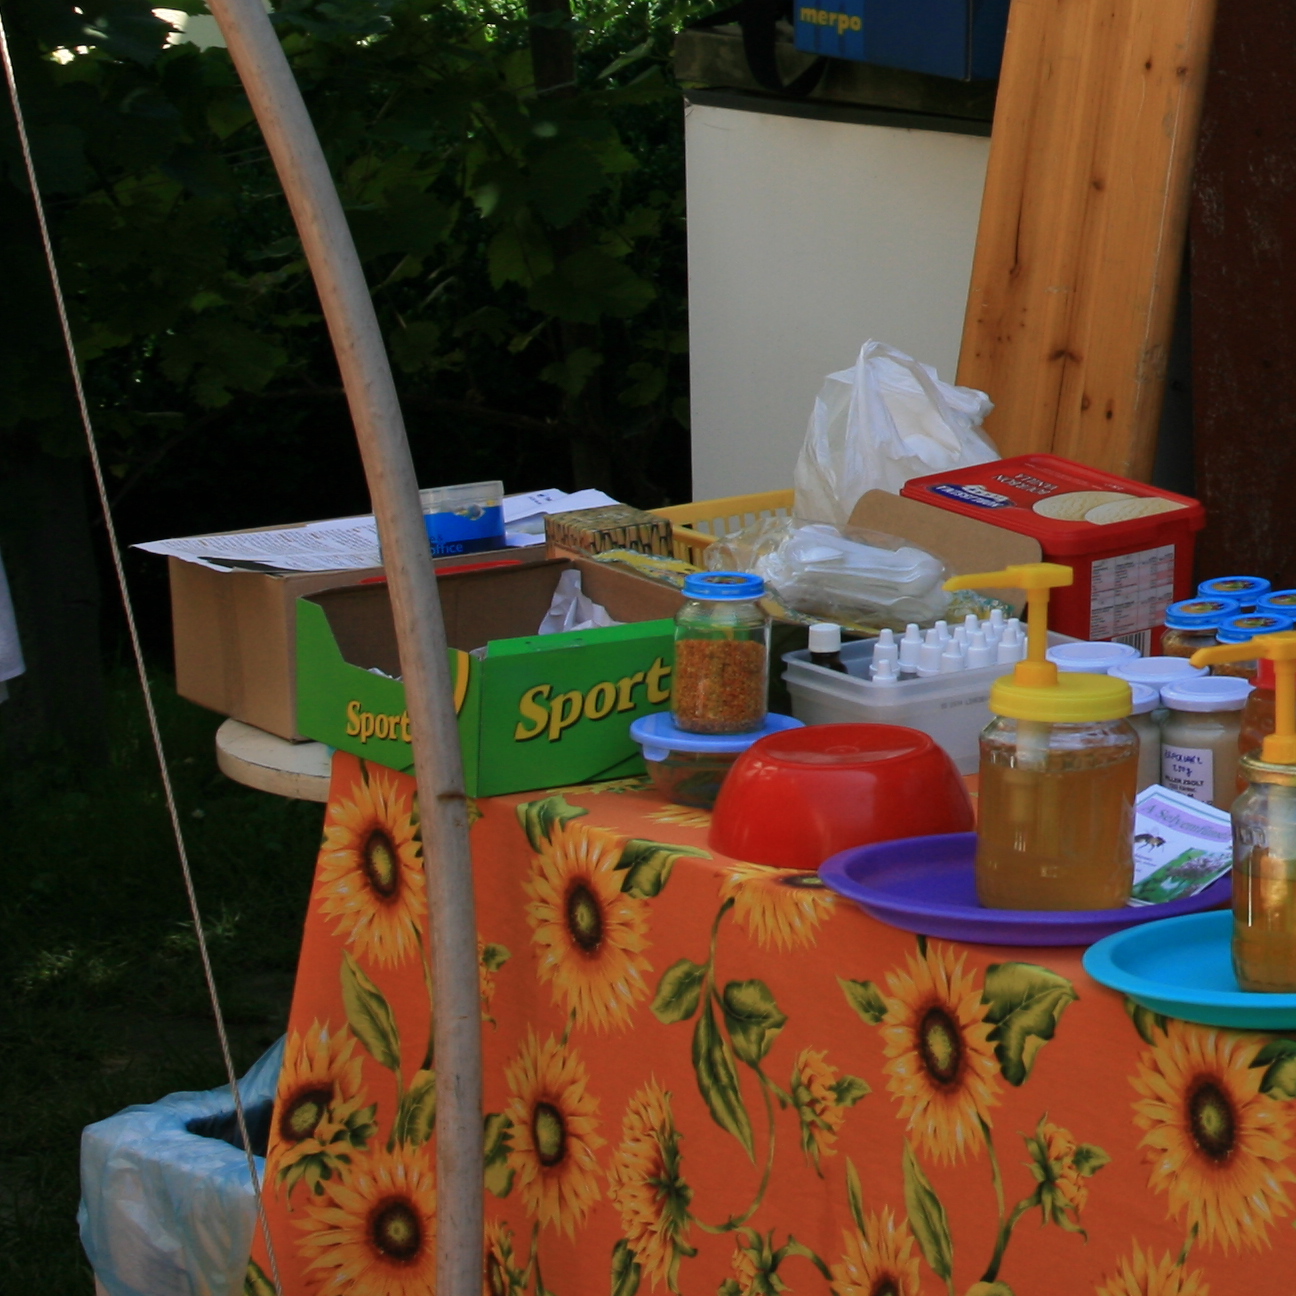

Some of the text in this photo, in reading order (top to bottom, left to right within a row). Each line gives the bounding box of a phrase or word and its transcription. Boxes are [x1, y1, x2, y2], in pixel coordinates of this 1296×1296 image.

[801, 6, 862, 35] merpo
[514, 656, 672, 741] Sport
[346, 700, 413, 743] Sport
